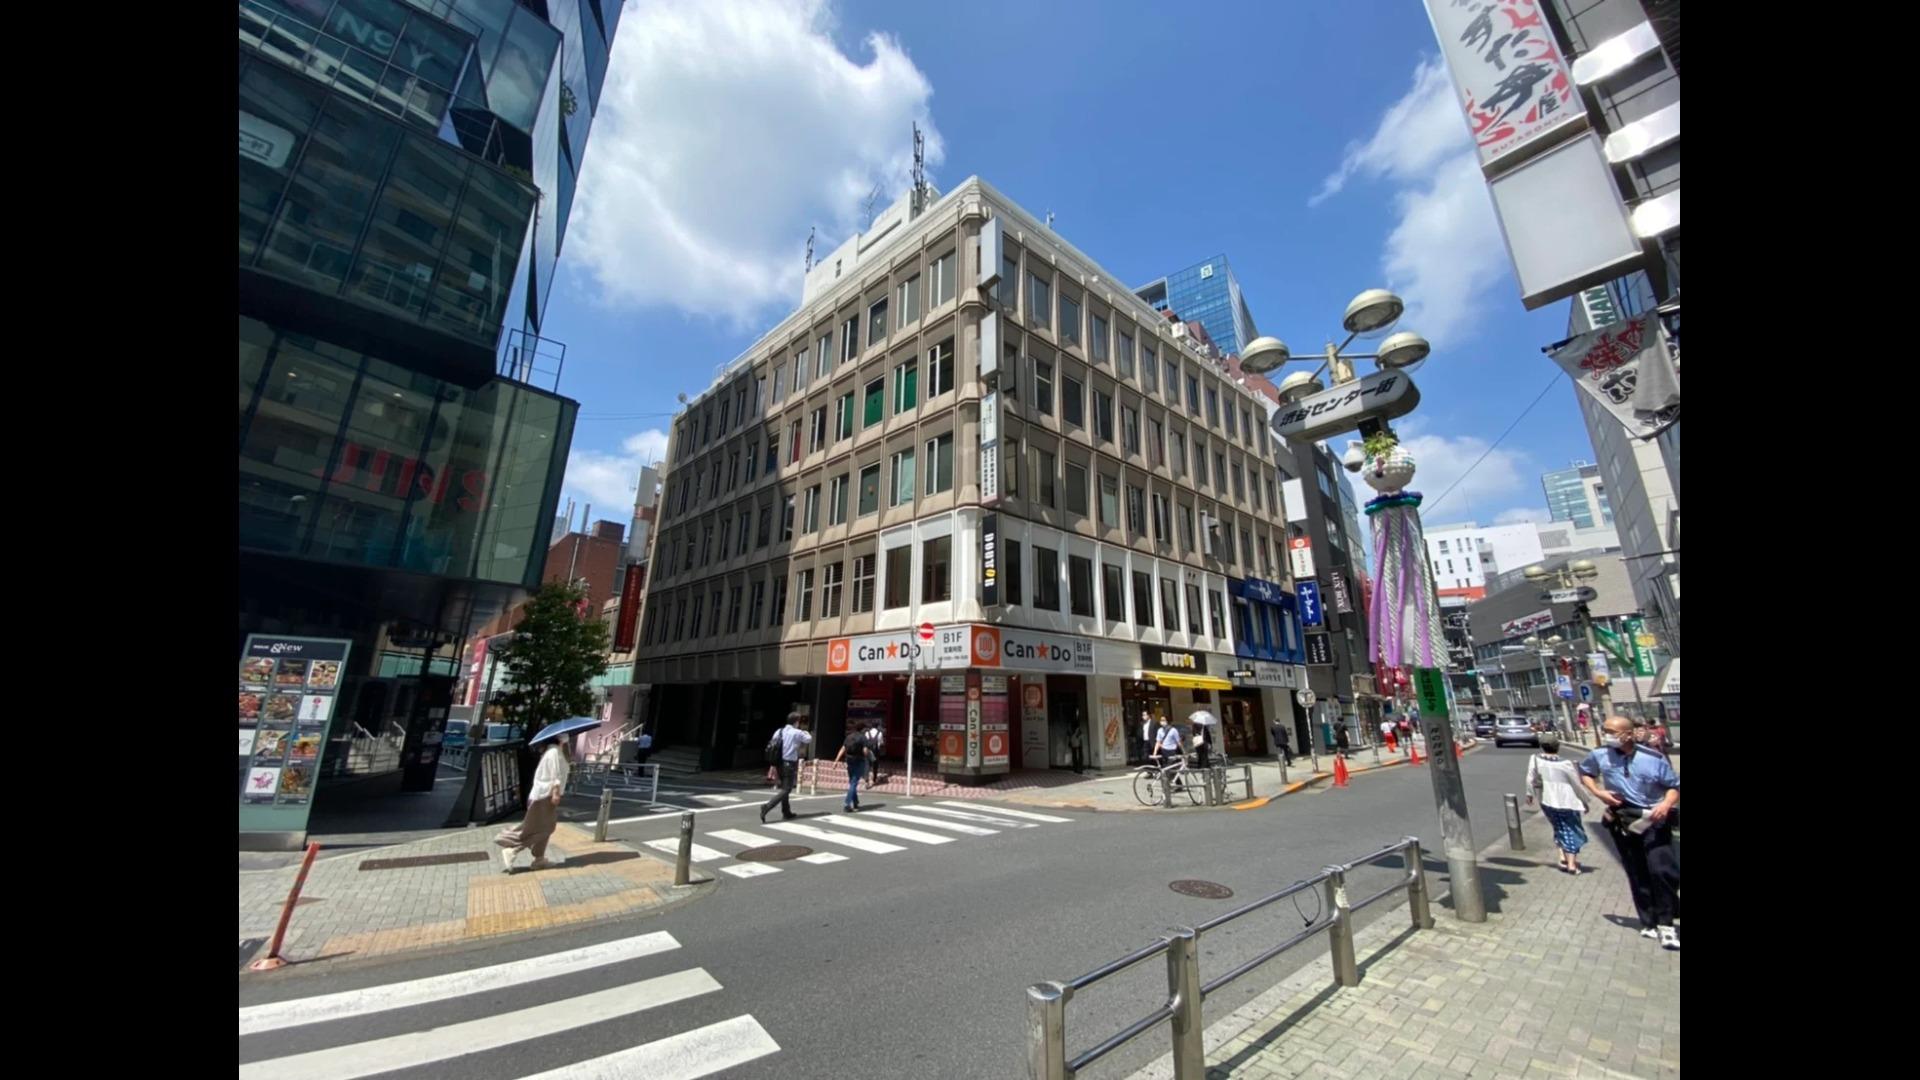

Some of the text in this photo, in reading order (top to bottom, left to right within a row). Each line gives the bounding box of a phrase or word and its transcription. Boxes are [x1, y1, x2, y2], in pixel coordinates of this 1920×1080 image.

[1279, 376, 1398, 427] 渋谷センター街
[310, 441, 491, 512] JINS
[943, 632, 963, 644] B1F
[858, 645, 885, 661] Can
[1004, 640, 1071, 661] Can Do
[1580, 686, 1590, 701] P
